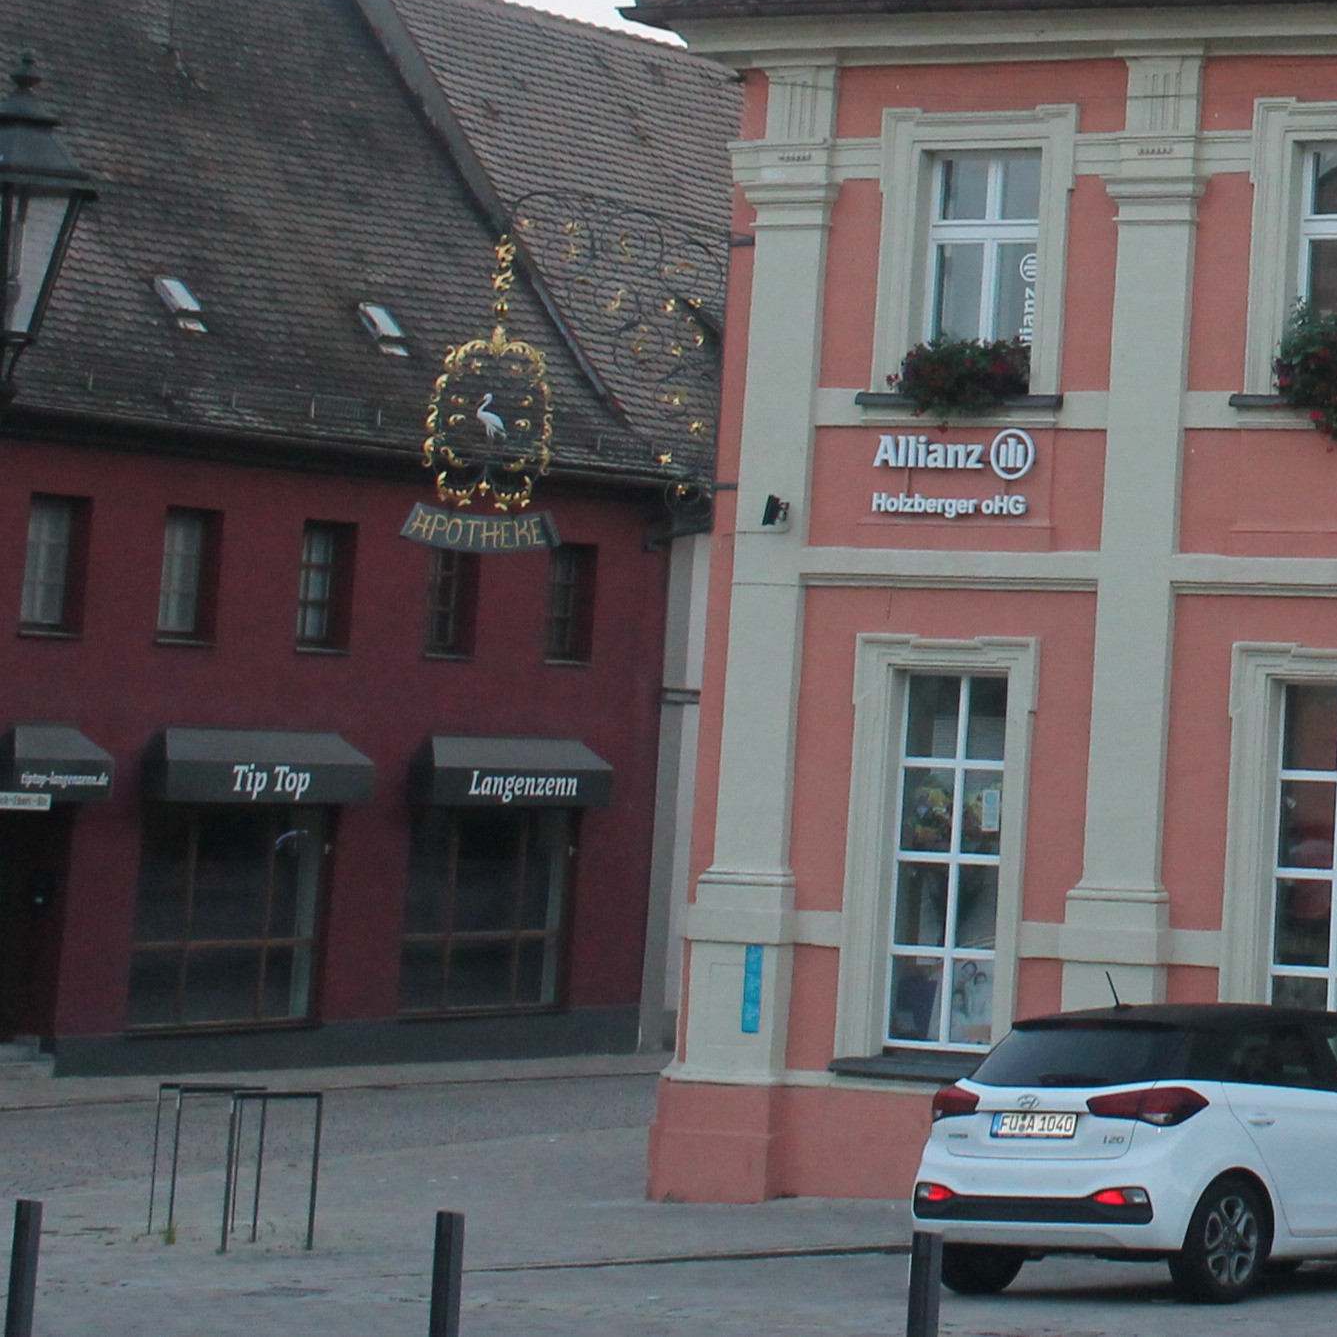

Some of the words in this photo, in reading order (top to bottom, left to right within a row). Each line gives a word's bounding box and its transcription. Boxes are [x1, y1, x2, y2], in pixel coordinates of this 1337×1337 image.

[873, 435, 984, 469] Allianz
[871, 492, 978, 519] Holzberger
[981, 494, 1027, 515] oHG
[408, 510, 546, 549] APOTHEKE
[232, 764, 269, 800] Tip
[273, 767, 312, 800] Top
[468, 770, 578, 802] Langenzenn
[1038, 1114, 1074, 1133] 1040
